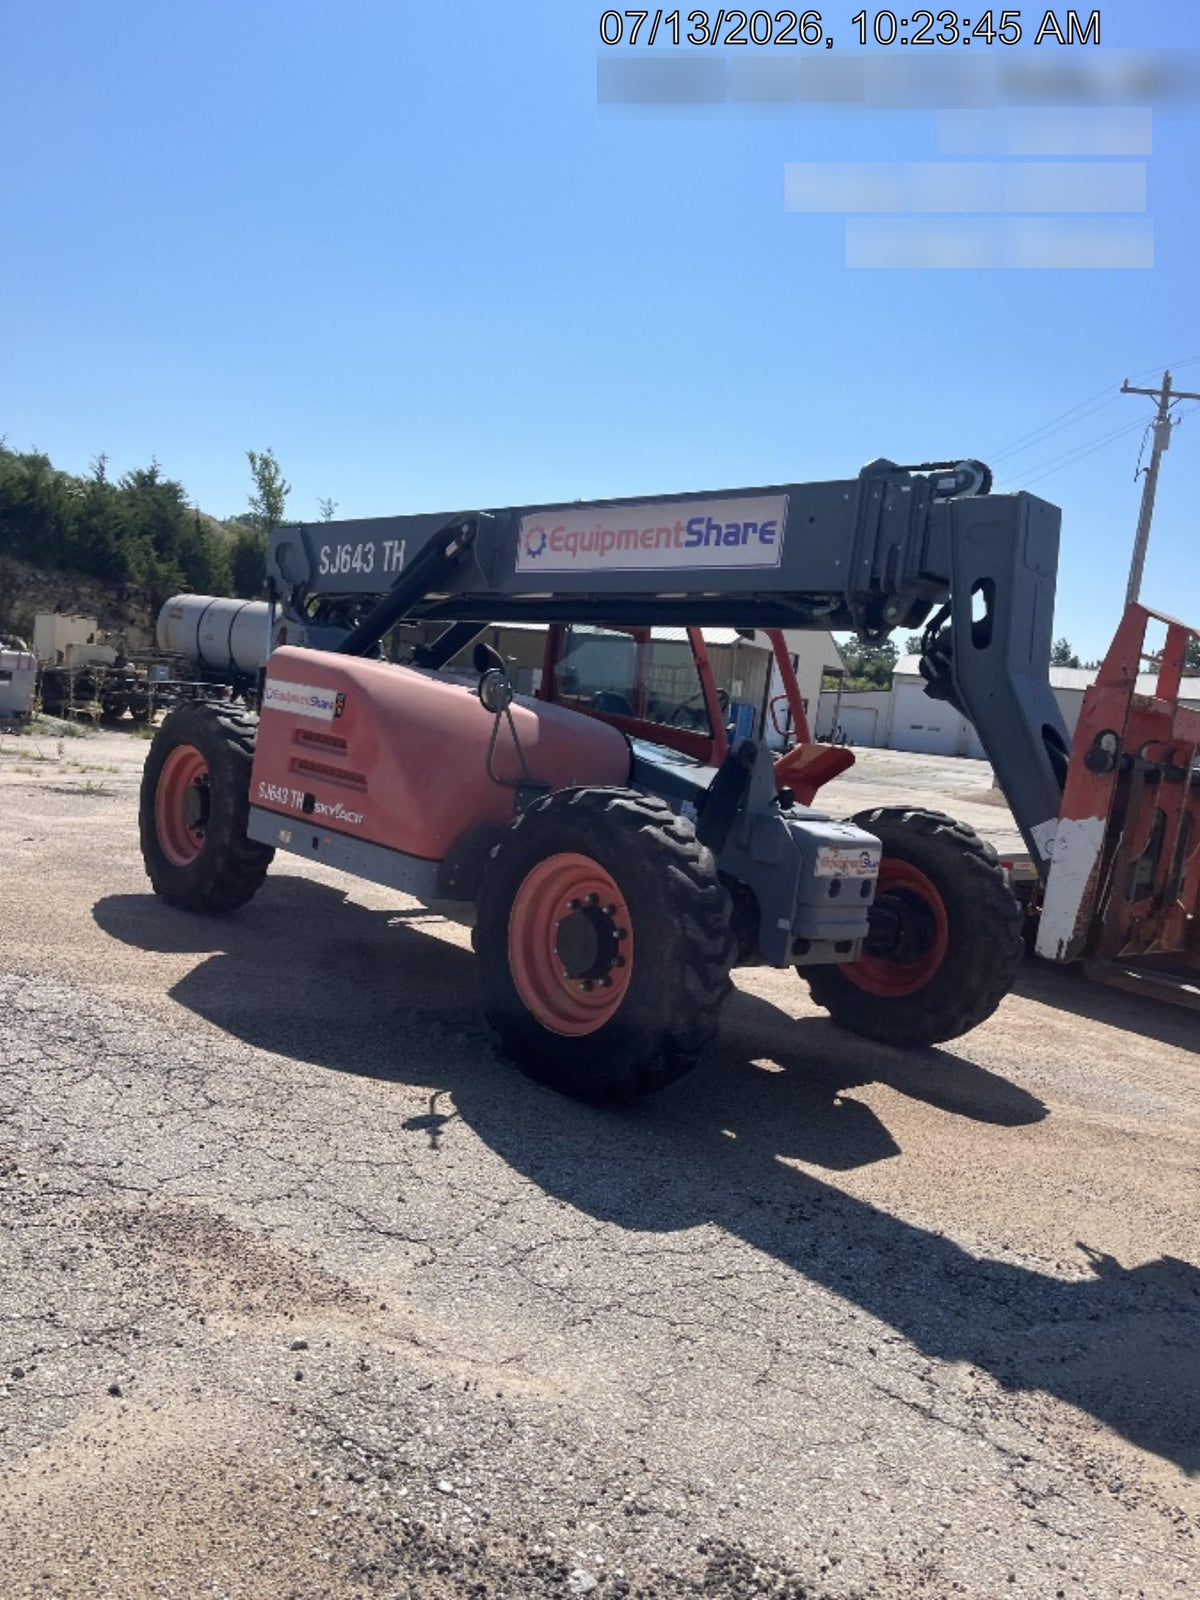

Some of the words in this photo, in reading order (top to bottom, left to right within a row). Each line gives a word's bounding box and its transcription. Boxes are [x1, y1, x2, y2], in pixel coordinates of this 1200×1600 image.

[549, 516, 778, 558] EquipmentShare
[319, 542, 376, 575] SJ643
[382, 539, 407, 572] TH
[258, 781, 289, 804] SJ643
[290, 787, 305, 810] TH
